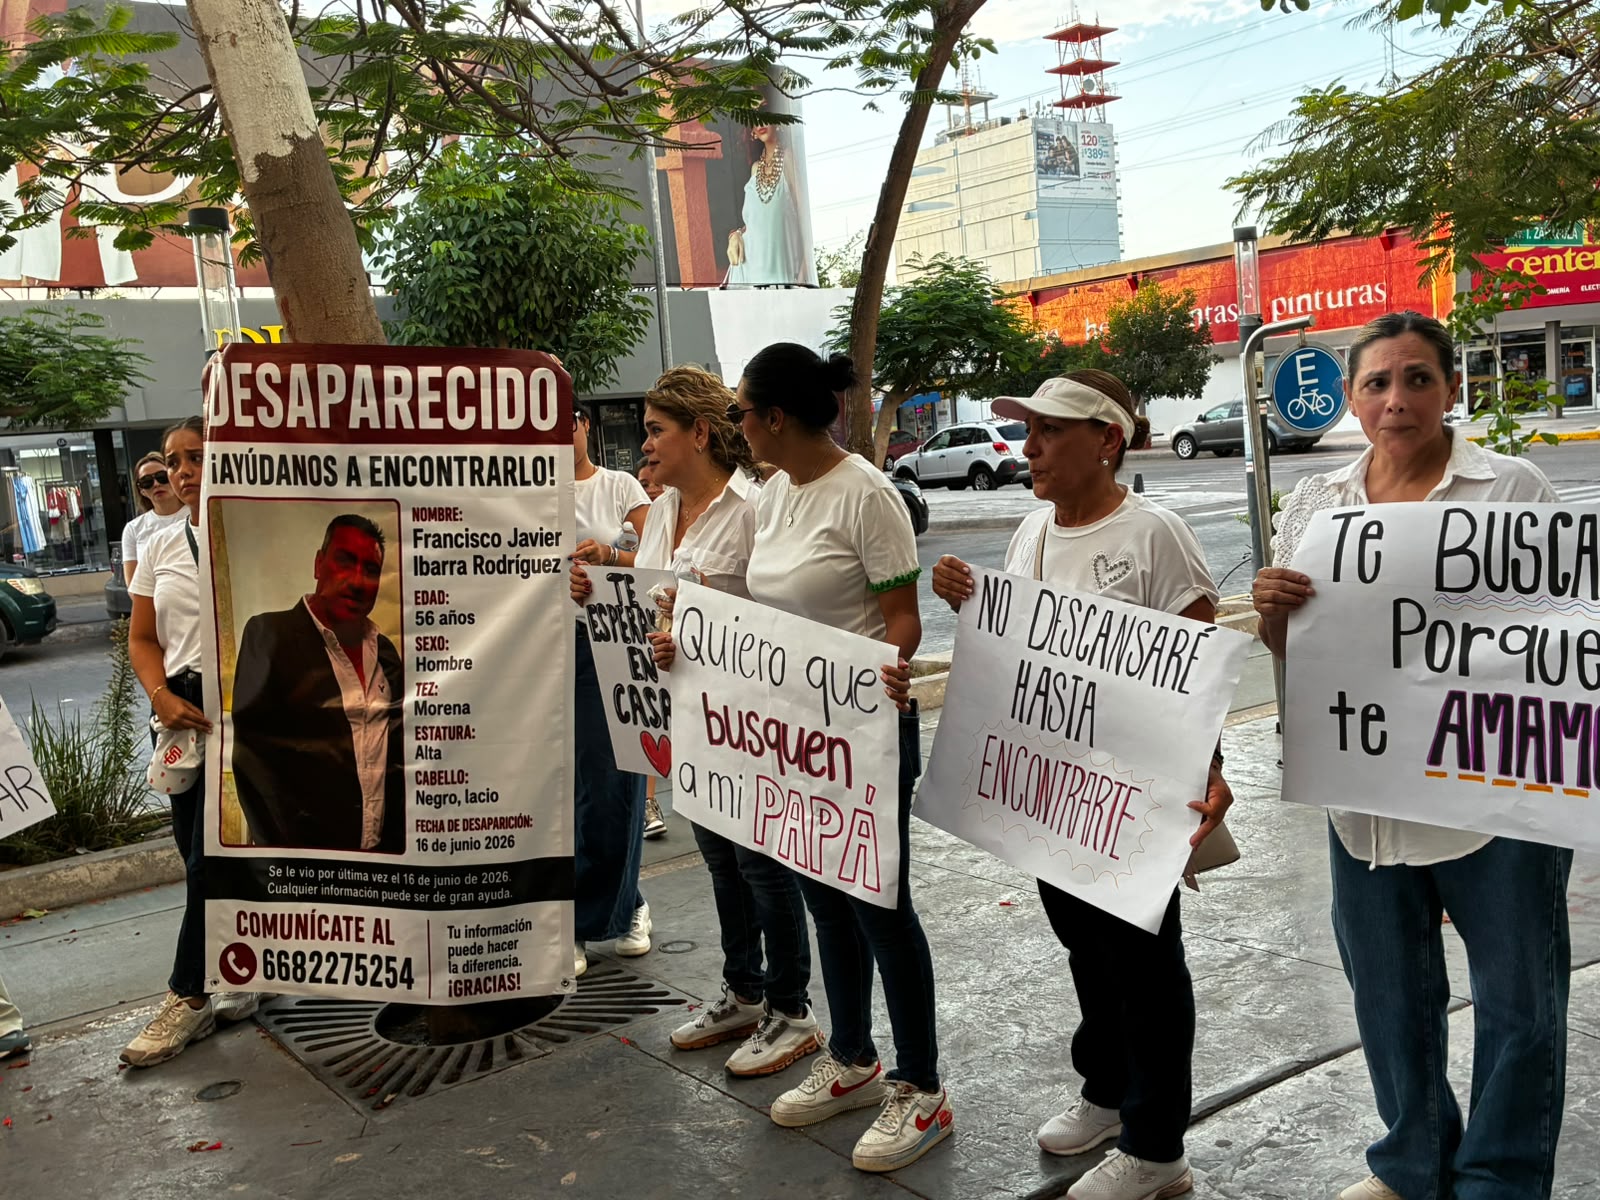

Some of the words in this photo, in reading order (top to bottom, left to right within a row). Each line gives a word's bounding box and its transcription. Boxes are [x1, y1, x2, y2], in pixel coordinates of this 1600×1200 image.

[1081, 135, 1098, 146] 120
[1271, 280, 1388, 322] pinturas
[1295, 352, 1319, 386] E
[208, 361, 558, 431] DESAPARECIDO
[211, 448, 338, 486] ¡AYÚDANOS
[346, 455, 363, 487] A
[369, 455, 556, 487] ENCONTRARLO!
[412, 507, 462, 521] NOMBRE:
[412, 528, 501, 548] Francisco
[507, 526, 561, 547] Javier
[1332, 511, 1384, 584] Te
[413, 555, 467, 576] Ibarra
[473, 553, 561, 579] Rodríguez
[414, 590, 449, 604] EDAD:
[606, 573, 640, 609] TE
[415, 611, 434, 625] 56
[438, 610, 474, 624] años
[415, 636, 448, 651] SEXO:
[977, 575, 1012, 637] NO
[1027, 588, 1217, 695] DESCANSARÉ
[415, 656, 472, 672] Hombre
[627, 646, 659, 683] EN
[680, 607, 786, 686] Quiero
[806, 656, 878, 726] que
[415, 682, 438, 696] TEZ:
[414, 700, 470, 715] Morena
[1011, 659, 1097, 748] HASTA
[414, 726, 475, 740] ESTATURA:
[702, 692, 852, 789] busquen
[1329, 691, 1387, 756] te
[1426, 690, 1600, 789] AMAM
[414, 745, 441, 759] Alta
[415, 770, 468, 785] CABELLO:
[415, 790, 461, 806] Negro,
[465, 789, 498, 803] lacio
[977, 735, 1142, 860] ENCONTRARTE
[415, 819, 445, 833] FECHA
[447, 818, 460, 832] DE
[462, 814, 532, 831] DESAPARICIÓN:
[679, 762, 697, 798] a
[708, 771, 743, 819] mi
[754, 775, 881, 893] PAPÁ
[416, 838, 428, 852] 16
[431, 837, 446, 852] de
[449, 835, 480, 853] junio
[484, 835, 514, 849] 2026
[268, 865, 282, 878] Se
[286, 866, 295, 878] le
[299, 866, 314, 879] vio
[318, 869, 334, 882] por
[338, 867, 368, 881] última
[372, 872, 387, 882] vez
[391, 872, 399, 883] el
[403, 873, 414, 885] 16
[418, 873, 430, 885] de
[433, 873, 460, 887] junio
[464, 872, 478, 885] de
[482, 871, 511, 883] 2026.
[267, 882, 318, 896] Cualquier
[321, 883, 378, 898] información
[381, 888, 411, 902] puede
[414, 891, 429, 901] ser
[433, 889, 445, 902] de
[450, 891, 474, 905] gran
[478, 888, 512, 903] ayuda.
[236, 908, 365, 943] COMUNÍCATE
[372, 918, 396, 946] AL
[447, 925, 460, 939] Tu
[464, 918, 532, 939] información
[447, 941, 484, 959] puede
[487, 938, 518, 955] hacer
[262, 949, 415, 990] 6682275254
[448, 958, 458, 973] la
[462, 955, 522, 973] diferencia.
[448, 972, 520, 997] ¡GRACIAS!
